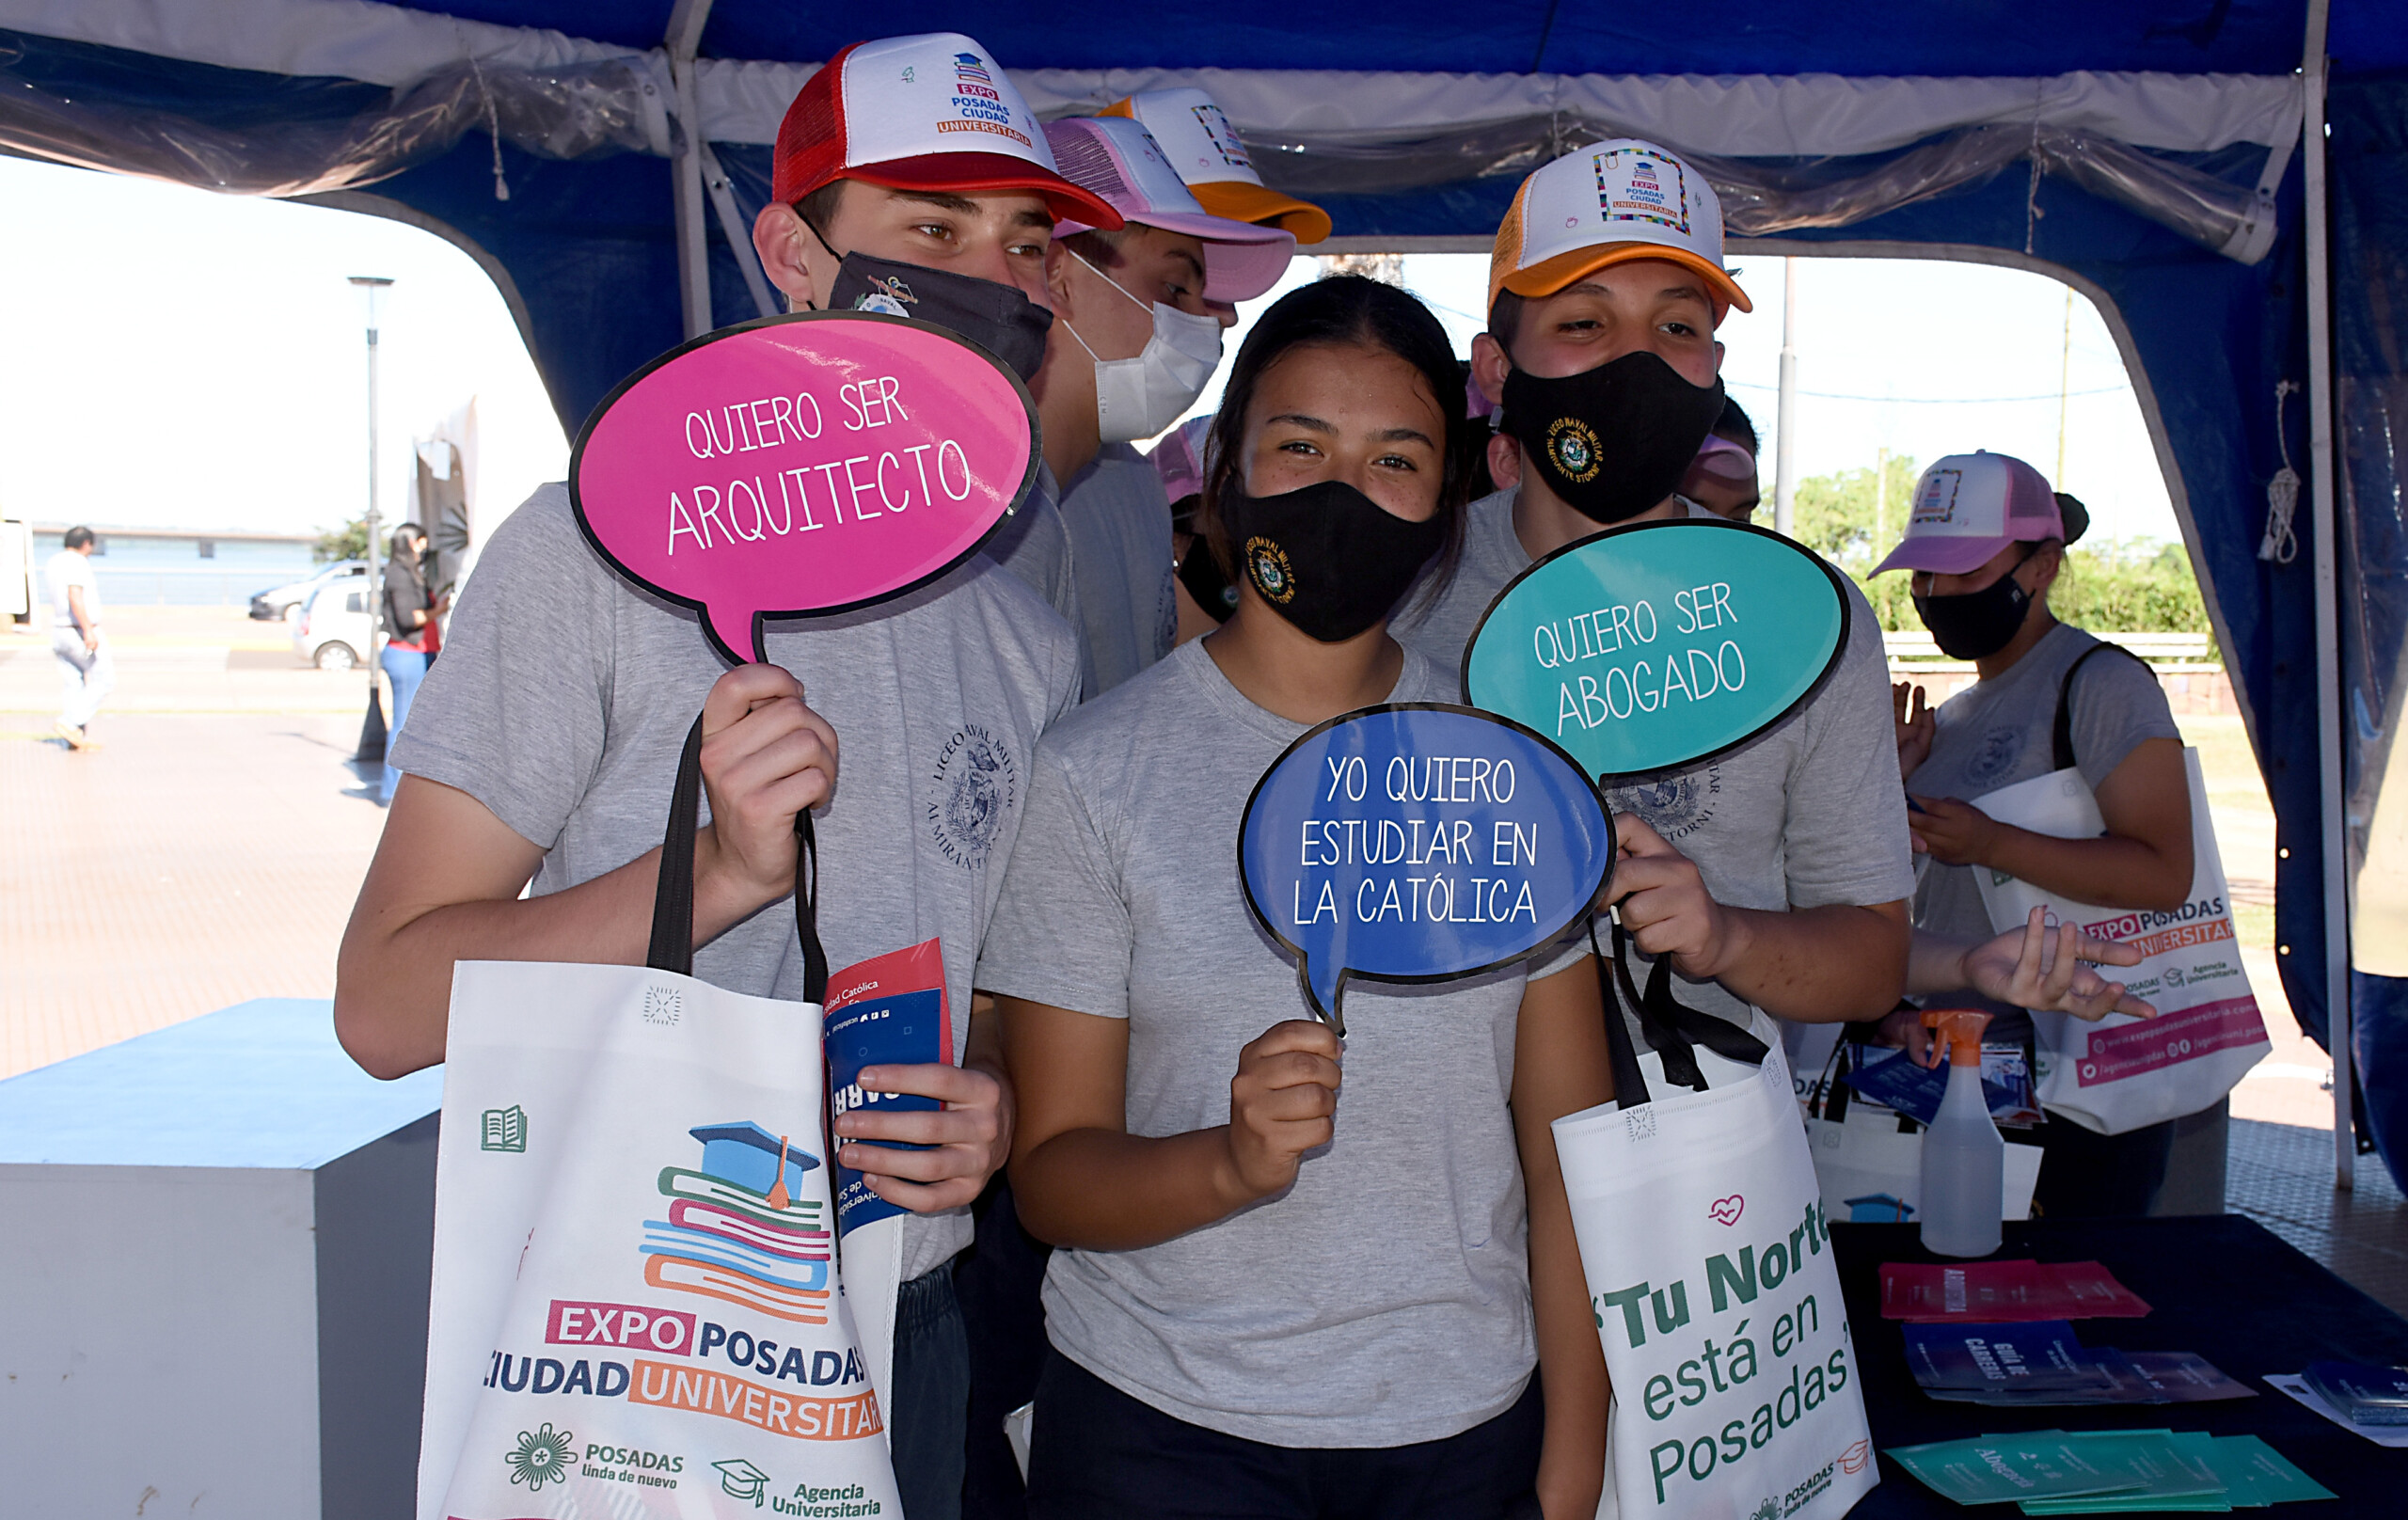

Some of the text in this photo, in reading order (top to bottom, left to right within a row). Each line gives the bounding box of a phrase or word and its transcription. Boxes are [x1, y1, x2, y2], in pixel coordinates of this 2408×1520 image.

[961, 86, 996, 99] EXPO
[951, 97, 1010, 117] POSADAS
[961, 108, 1008, 124] CIUDAD
[939, 121, 1030, 146] UNIVERSITARIA
[1626, 188, 1665, 199] POSADAS
[1633, 181, 1658, 191] EXPO
[1614, 201, 1677, 217] UNIVERSITARIA
[1630, 195, 1662, 205] CIUDAD
[686, 375, 909, 459] QUIERO SER
[668, 438, 972, 556] ARQUITECTO
[1533, 582, 1738, 669] QUIERO SER
[1558, 640, 1746, 737] ABOGADO
[933, 732, 965, 782] LICEO
[1326, 756, 1515, 803] YO QUIERO
[1664, 810, 1714, 842] TORNI
[1301, 819, 1537, 866] ESTUDIAR EN
[1294, 872, 1537, 925] LA CATÓLICA
[2187, 968, 2239, 985] Universitaria
[2193, 961, 2227, 974] Agencia
[842, 979, 879, 1000] Católica
[2126, 977, 2161, 993] OSADAS
[849, 1180, 863, 1194] de
[558, 1307, 865, 1387] EXPO POSADAS
[1643, 1293, 1818, 1421] está en
[586, 1444, 685, 1473] POSADAS
[581, 1464, 677, 1490] linda de nuevo
[1784, 1463, 1834, 1507] POSADAS
[794, 1483, 864, 1503] Agencia
[772, 1496, 881, 1518] Universitaria
